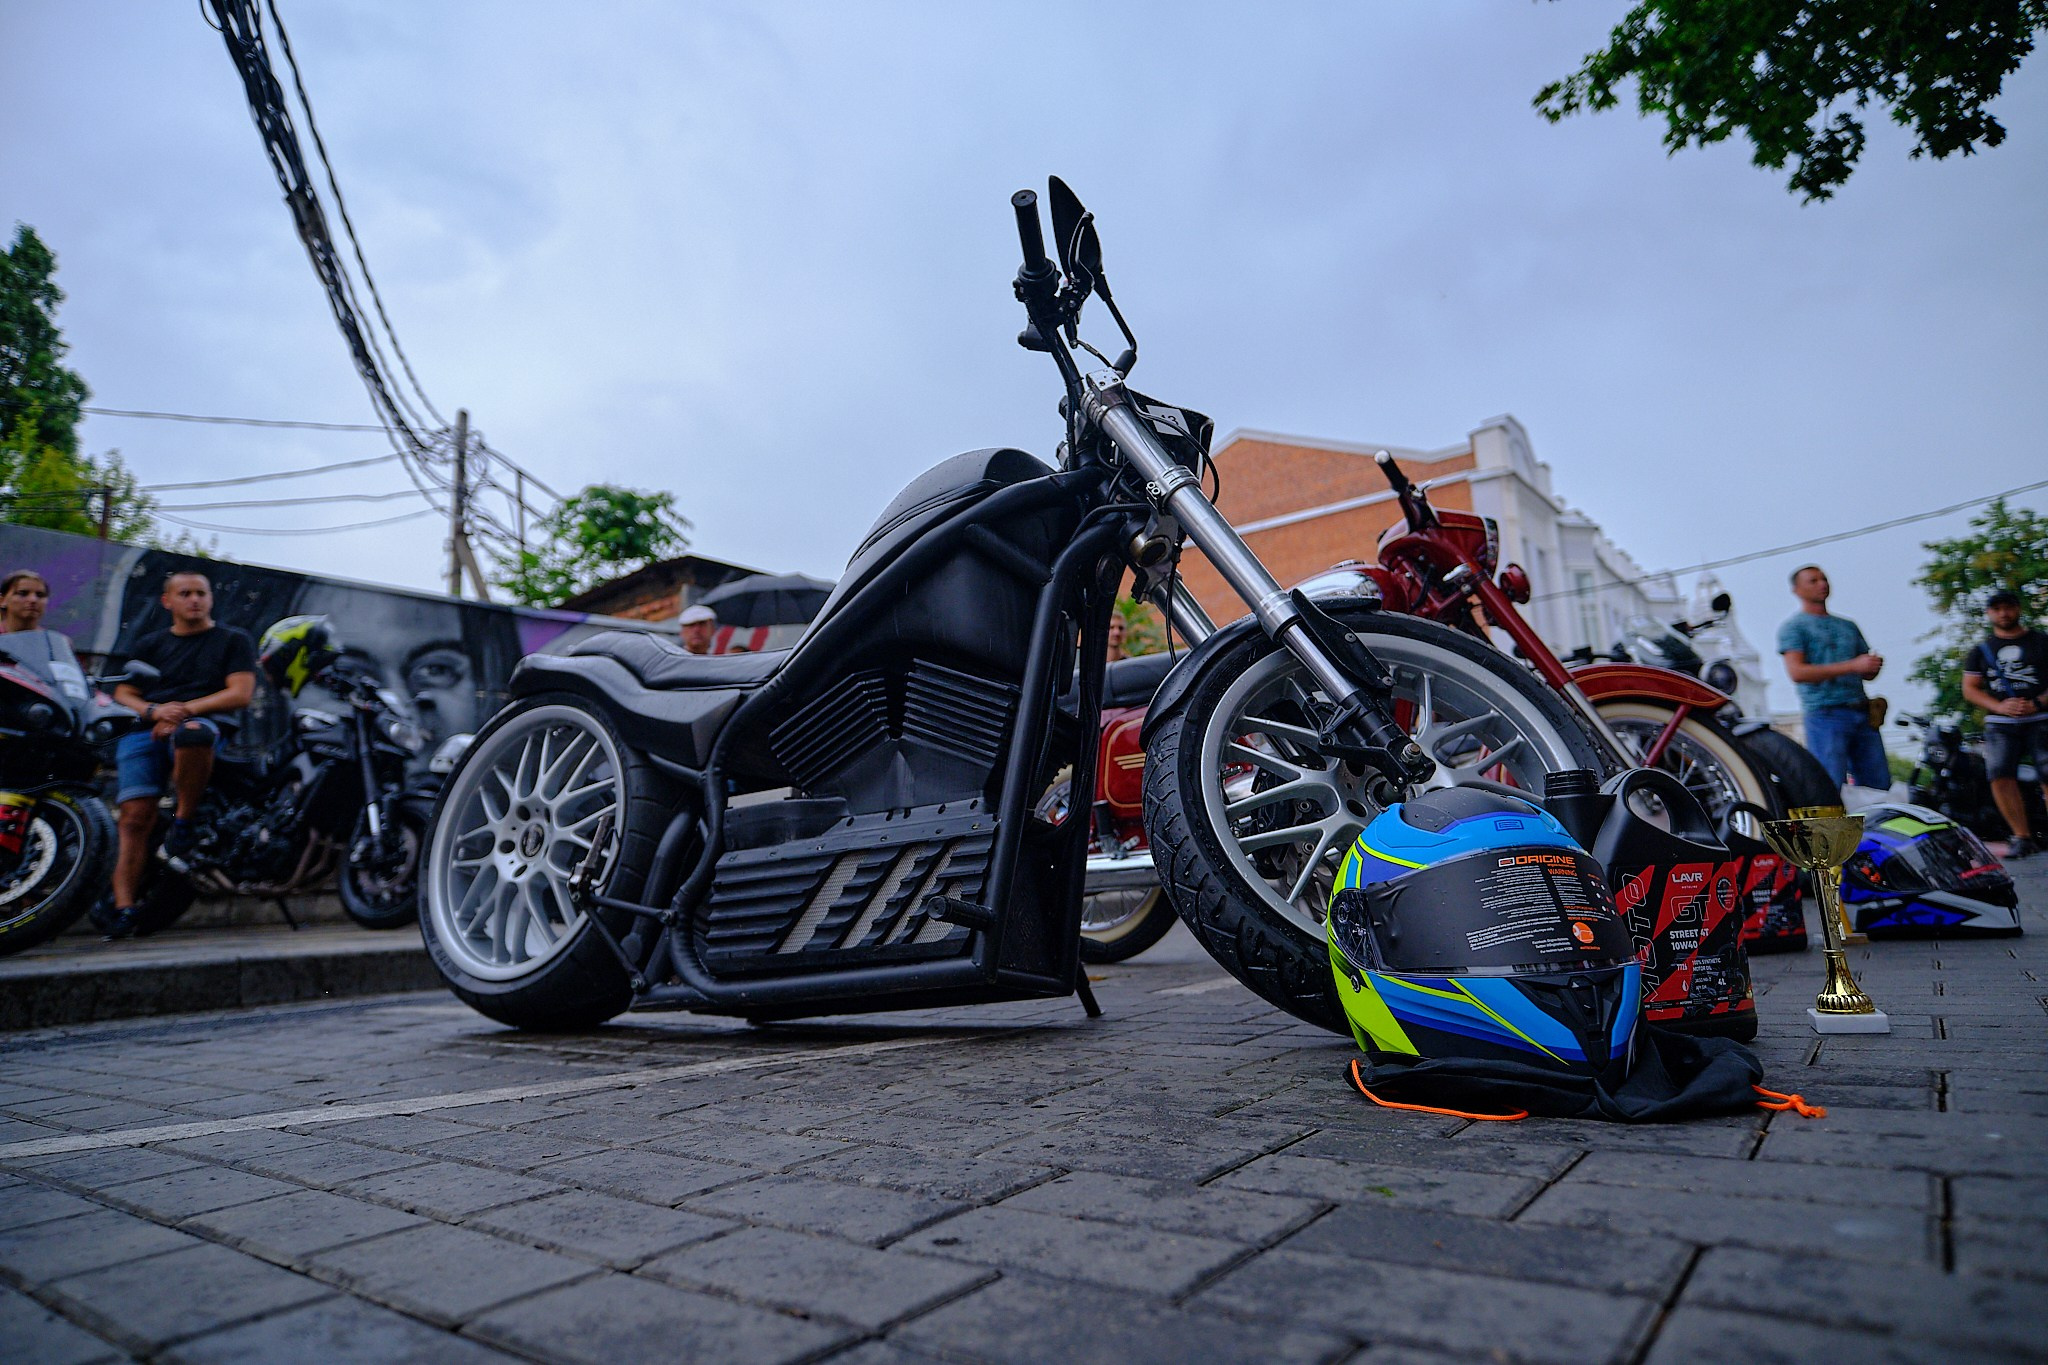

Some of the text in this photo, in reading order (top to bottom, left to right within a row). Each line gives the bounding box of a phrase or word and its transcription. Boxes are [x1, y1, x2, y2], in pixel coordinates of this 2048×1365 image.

[1515, 855, 1575, 865] ORIGINE
[1547, 868, 1578, 877] WARNING
[1671, 872, 1703, 883] LAVR
[1670, 894, 1711, 923] GT
[1669, 927, 1710, 940] STREET 4T
[1671, 939, 1698, 951] 10W40
[1717, 977, 1727, 986] 4L
